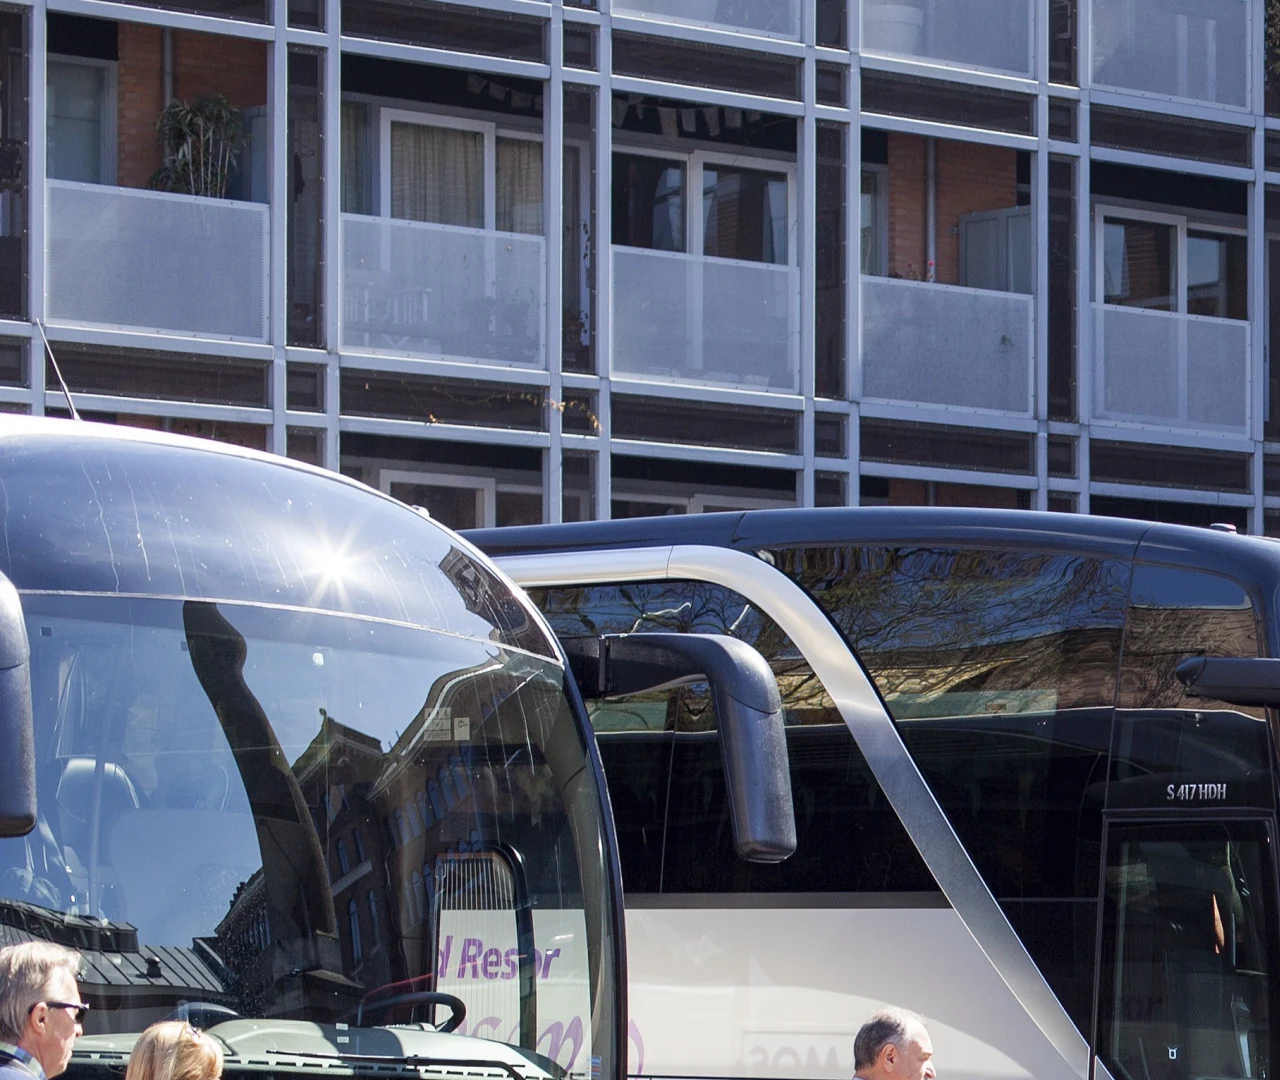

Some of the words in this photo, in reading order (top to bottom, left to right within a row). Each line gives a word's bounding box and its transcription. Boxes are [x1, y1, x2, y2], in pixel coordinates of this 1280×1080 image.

[1166, 784, 1175, 800] S
[1176, 784, 1197, 801] 417
[1198, 783, 1227, 800] HDH
